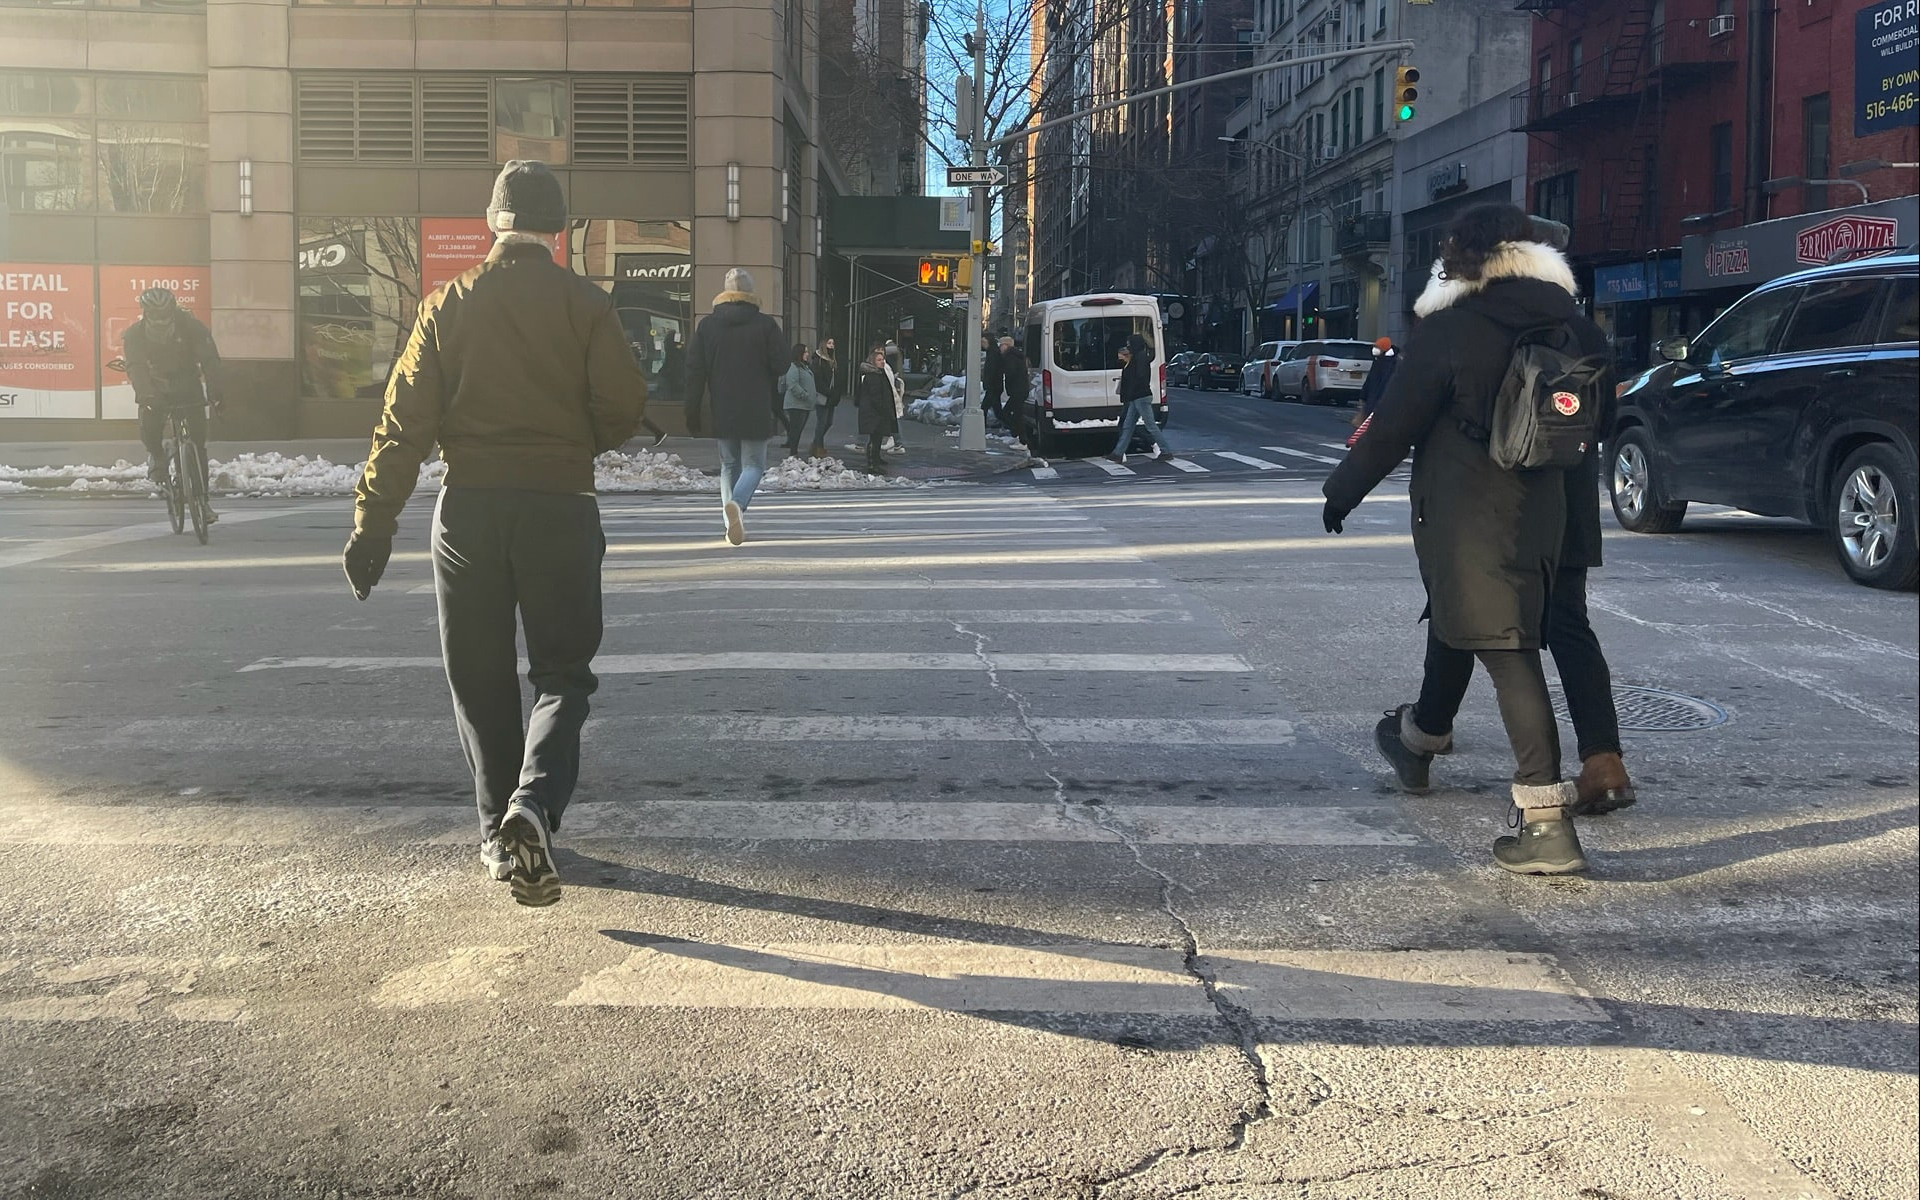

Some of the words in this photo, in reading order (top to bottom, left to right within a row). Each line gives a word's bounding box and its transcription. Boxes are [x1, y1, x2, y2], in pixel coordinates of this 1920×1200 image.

[1874, 5, 1902, 30] FOR
[1906, 0, 1919, 19] R
[1872, 25, 1919, 48] COMMERCIAL
[1880, 47, 1895, 57] WILL
[1895, 40, 1913, 53] BUILD
[1882, 77, 1895, 91] BY
[1866, 92, 1919, 120] 516-466-
[955, 172, 973, 181] ONE
[980, 172, 999, 181] WAY
[1857, 224, 1890, 257] PIZZA
[1715, 248, 1749, 276] PIZZA
[182, 279, 200, 291] SF
[7, 301, 53, 320] FOR
[3, 362, 23, 370] USES
[24, 362, 75, 371] CONSIDERED
